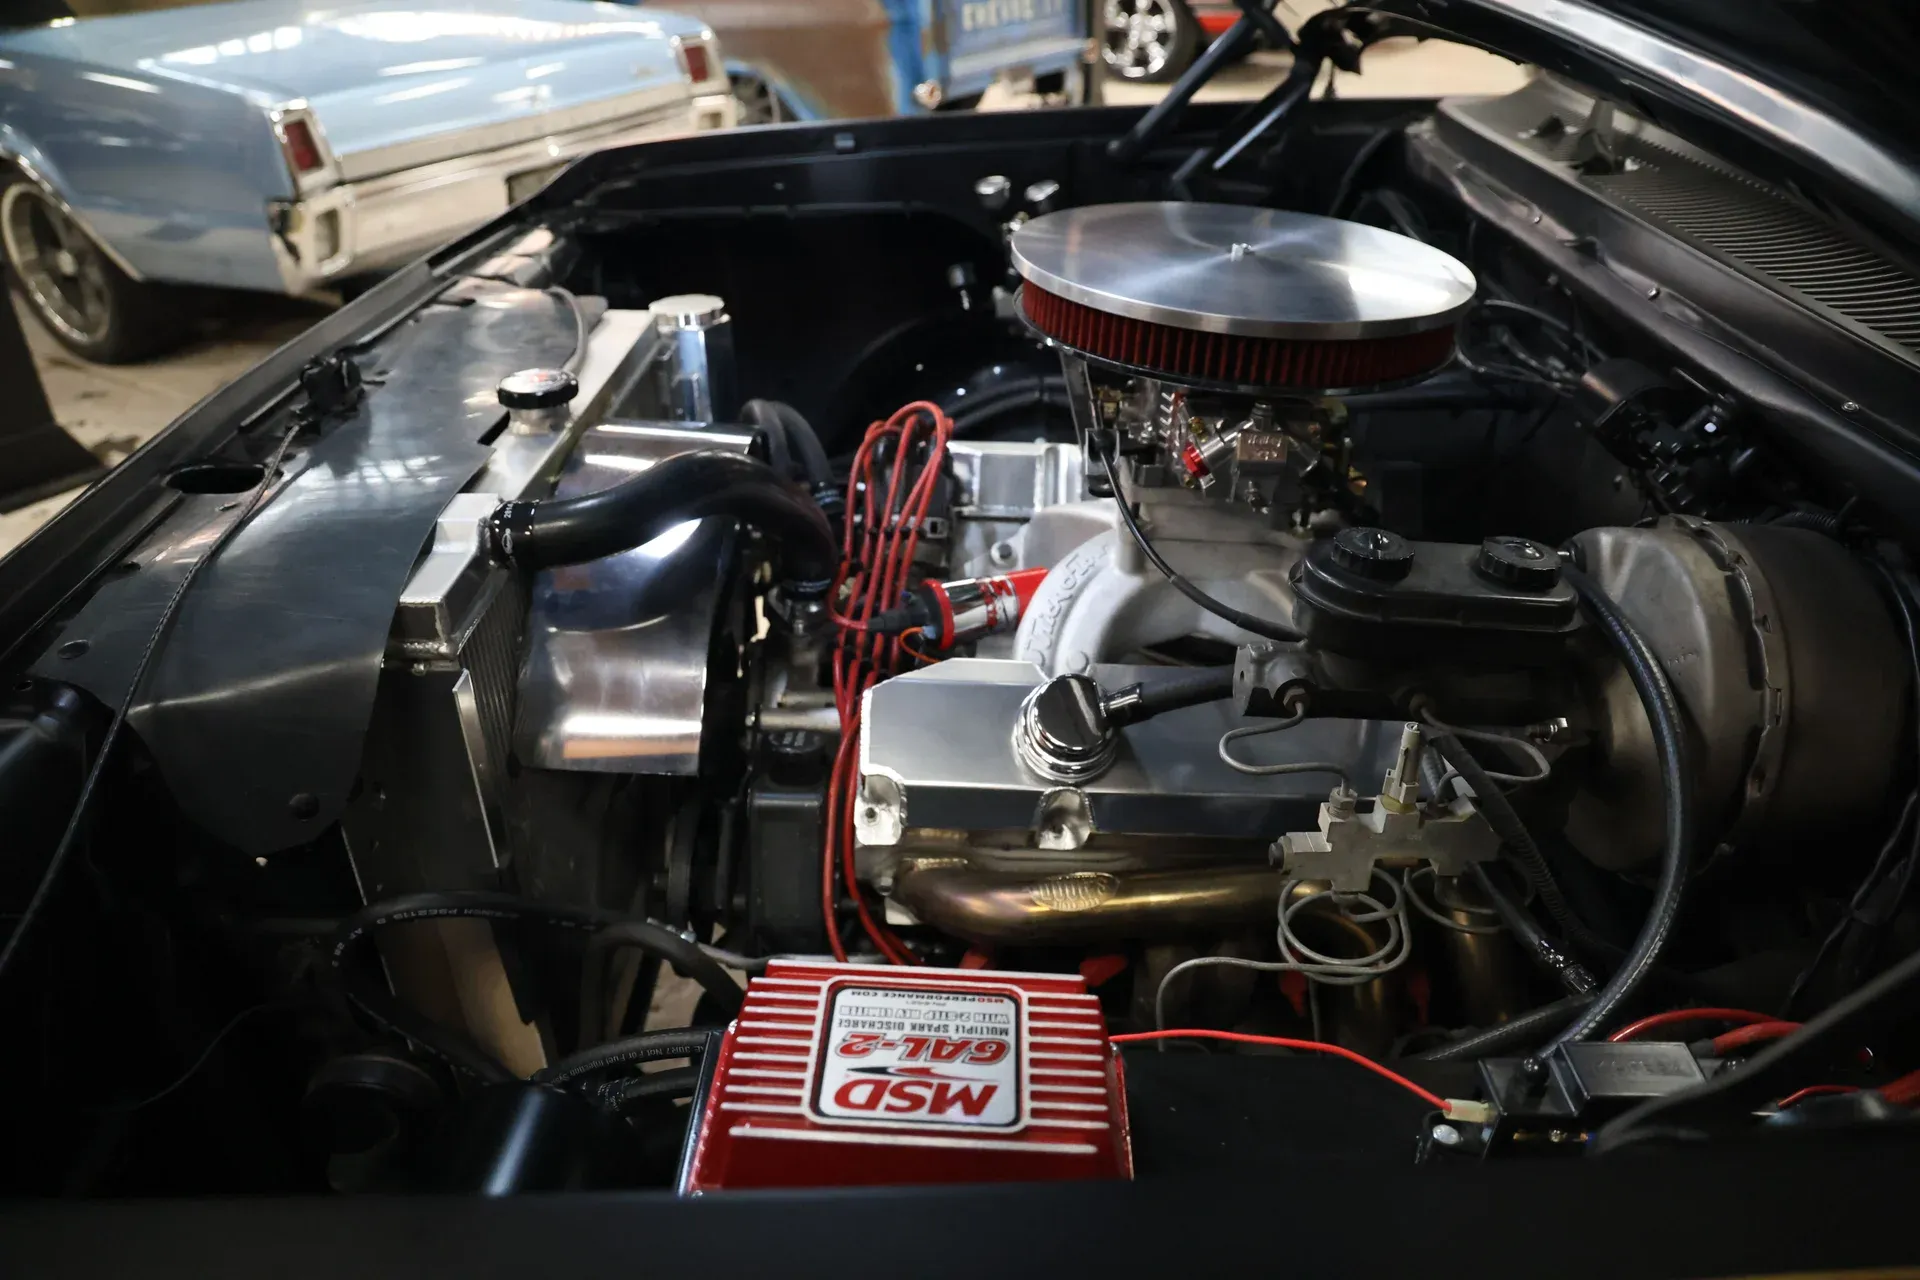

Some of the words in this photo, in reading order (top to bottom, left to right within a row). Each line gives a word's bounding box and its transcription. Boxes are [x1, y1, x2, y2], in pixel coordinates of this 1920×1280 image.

[838, 1018, 905, 1031] DISCHARGE
[909, 1021, 950, 1034] SPARK
[954, 1022, 1010, 1036] MULTIPLE
[834, 1031, 1011, 1066] 6AL-2
[605, 1053, 626, 1064] Fuel
[833, 1077, 999, 1117] MSD
